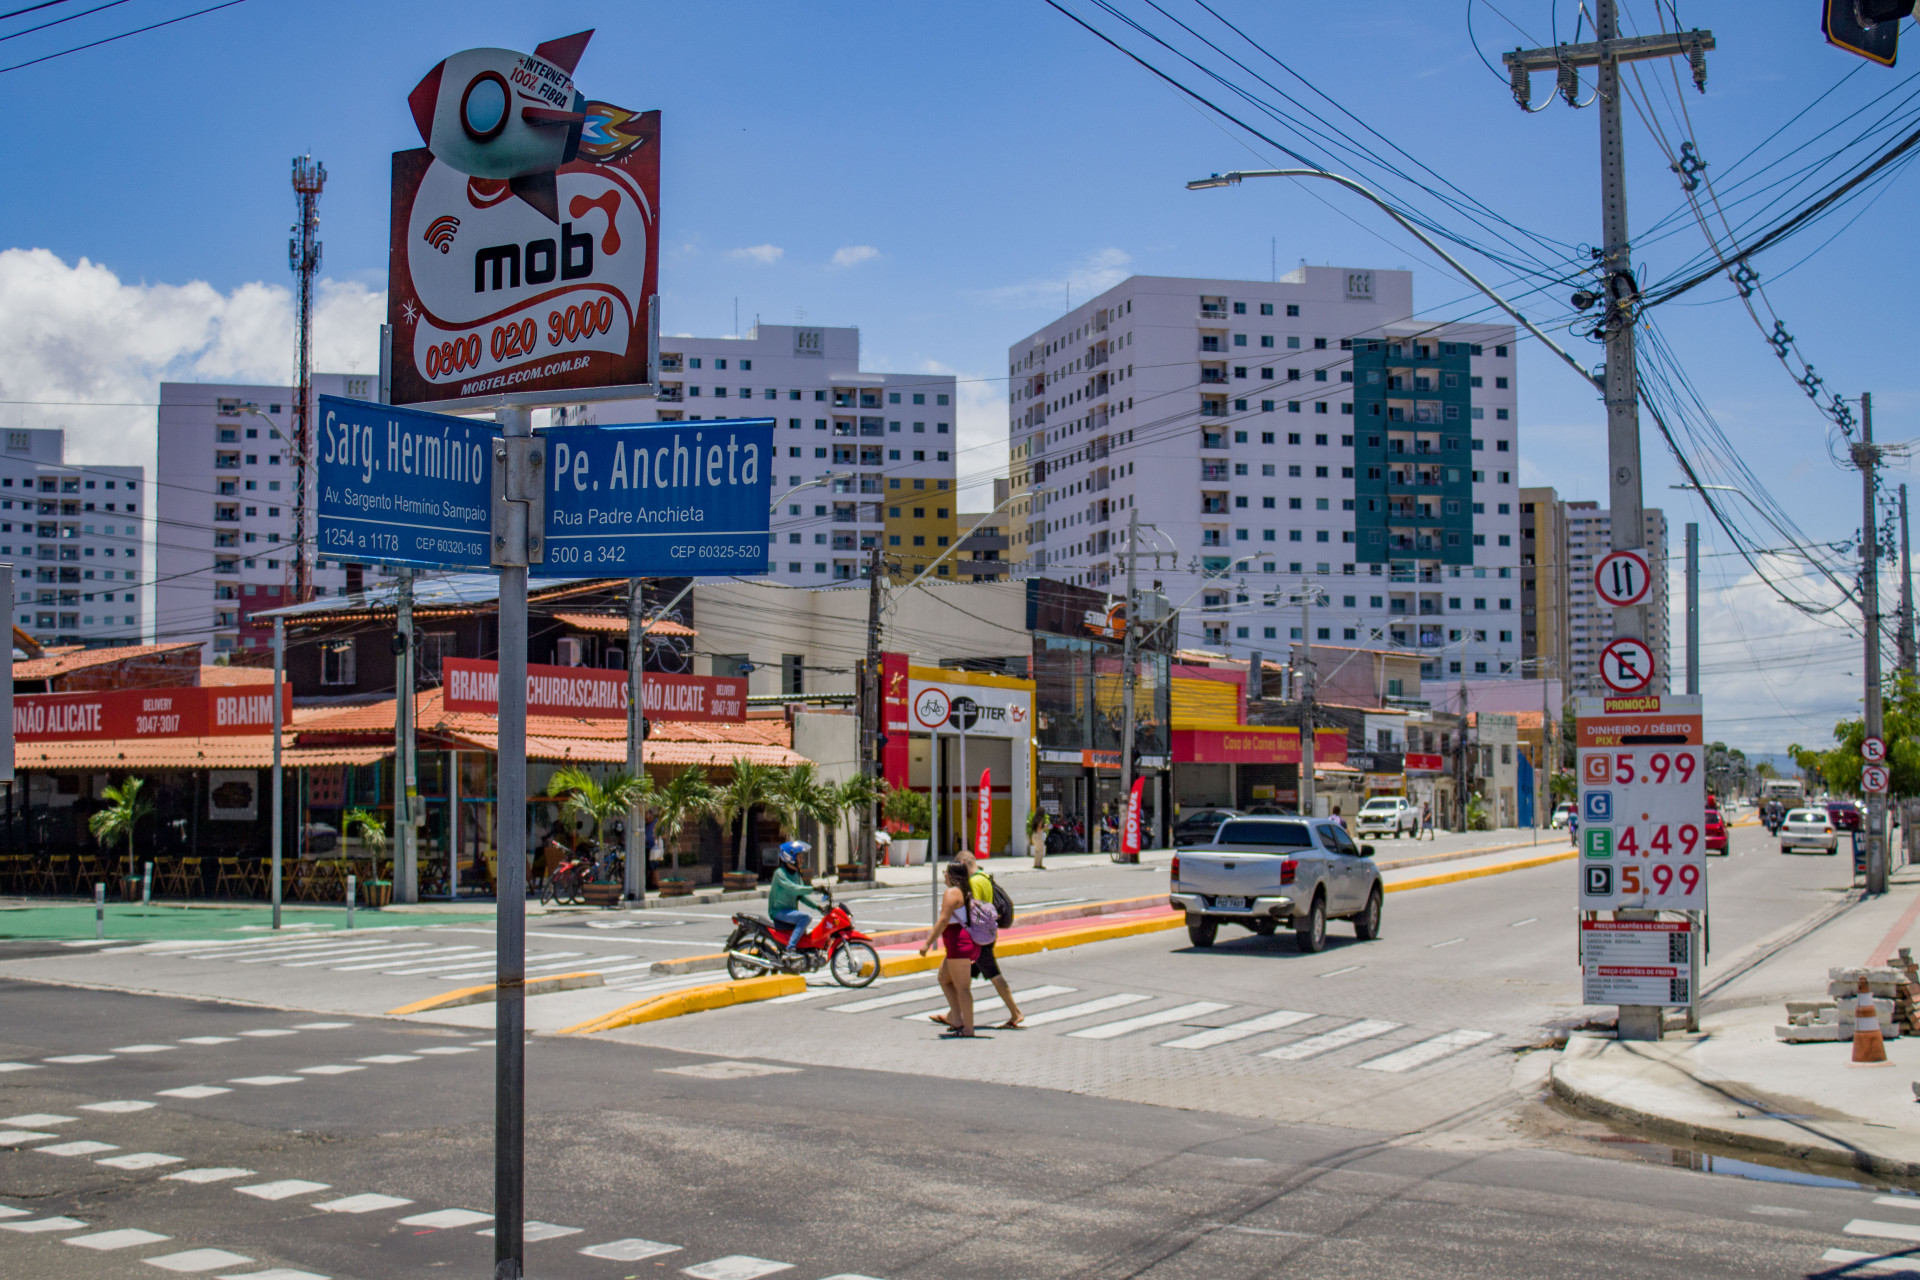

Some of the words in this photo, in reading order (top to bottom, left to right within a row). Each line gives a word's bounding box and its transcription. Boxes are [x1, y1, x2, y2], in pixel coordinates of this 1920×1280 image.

[510, 67, 539, 91] 100%
[538, 82, 568, 109] FIBRA
[474, 222, 594, 293] mob
[426, 333, 482, 379] 0800
[490, 318, 537, 362] 020
[547, 296, 613, 346] 9000
[461, 356, 591, 396] MOBTELECOM.COM.BR
[325, 410, 380, 484] Sarg.
[388, 420, 482, 485] Hermínio
[554, 442, 599, 491] Pe.
[609, 432, 759, 490] Anchieta
[324, 486, 341, 503] Av.
[344, 487, 392, 511] Sargento
[394, 494, 440, 516] Hermínio
[442, 500, 487, 523] Sampaio
[553, 509, 583, 525] Rua
[588, 507, 633, 525] Padre
[636, 505, 704, 523] Anchieta
[325, 527, 355, 546] 1254
[358, 536, 366, 548] a
[370, 532, 399, 551] 1178
[416, 537, 436, 550] CEP
[437, 540, 483, 555] 60320-105
[670, 545, 696, 558] CEP
[698, 544, 760, 558] 60325-520
[551, 546, 579, 563] 500
[583, 550, 593, 562] a
[597, 545, 626, 562] 342
[1617, 651, 1638, 680] E
[450, 669, 498, 702] BRAHM
[526, 675, 618, 709] CHURRASCARIA
[663, 684, 705, 712] ALICATE
[716, 684, 736, 696] DELIVERY
[47, 704, 102, 733] ALICATE
[143, 698, 173, 712] DELIVERY
[217, 695, 284, 726] BRAHM
[1605, 698, 1659, 712] PROMOÇÃO
[136, 714, 180, 734] 3047-3017
[1587, 725, 1641, 735] DINHEIRO
[1651, 723, 1691, 734] DÉBITO
[1224, 736, 1241, 750] Casa
[1242, 736, 1252, 750] de
[1253, 736, 1275, 750] Carnes
[1277, 737, 1296, 750] Monte
[1595, 736, 1613, 745] PIX
[1590, 758, 1605, 776] G
[1615, 752, 1696, 784] 5.99
[1591, 795, 1606, 814] G
[978, 786, 990, 854] MOTUL
[1126, 791, 1138, 849] MOTUL
[1593, 832, 1605, 851] E
[1617, 823, 1699, 858] 4.49
[1591, 869, 1607, 888] D
[1621, 864, 1700, 895] 5.99
